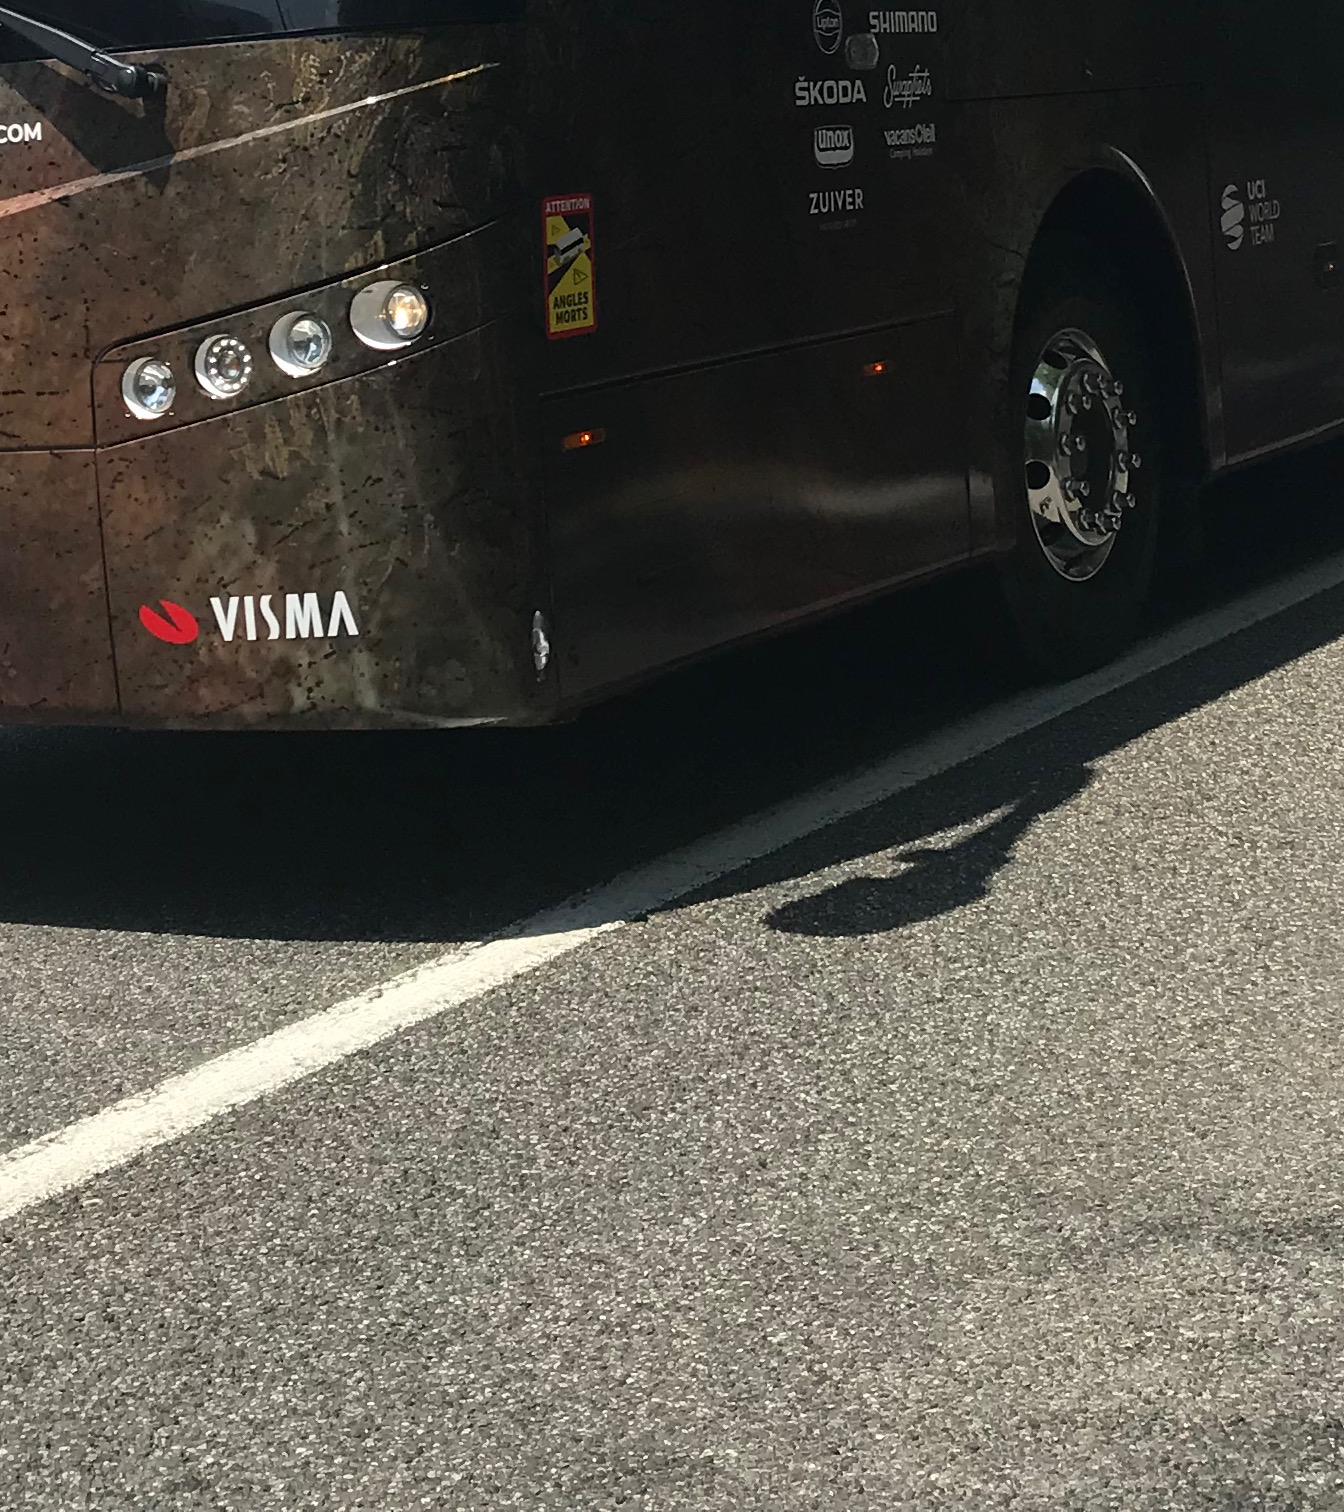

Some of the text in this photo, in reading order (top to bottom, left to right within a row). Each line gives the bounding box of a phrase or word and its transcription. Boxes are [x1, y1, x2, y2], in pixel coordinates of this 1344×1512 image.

[869, 11, 938, 33] SHIMANO
[794, 76, 867, 106] ŠKODA
[1246, 179, 1266, 200] UCI
[544, 197, 591, 213] ATTENTION
[808, 188, 864, 215] ZUIVER
[1249, 223, 1275, 246] TEAM
[553, 291, 589, 310] ANGLES
[555, 307, 589, 325] MORTS
[209, 590, 359, 642] VISMA
